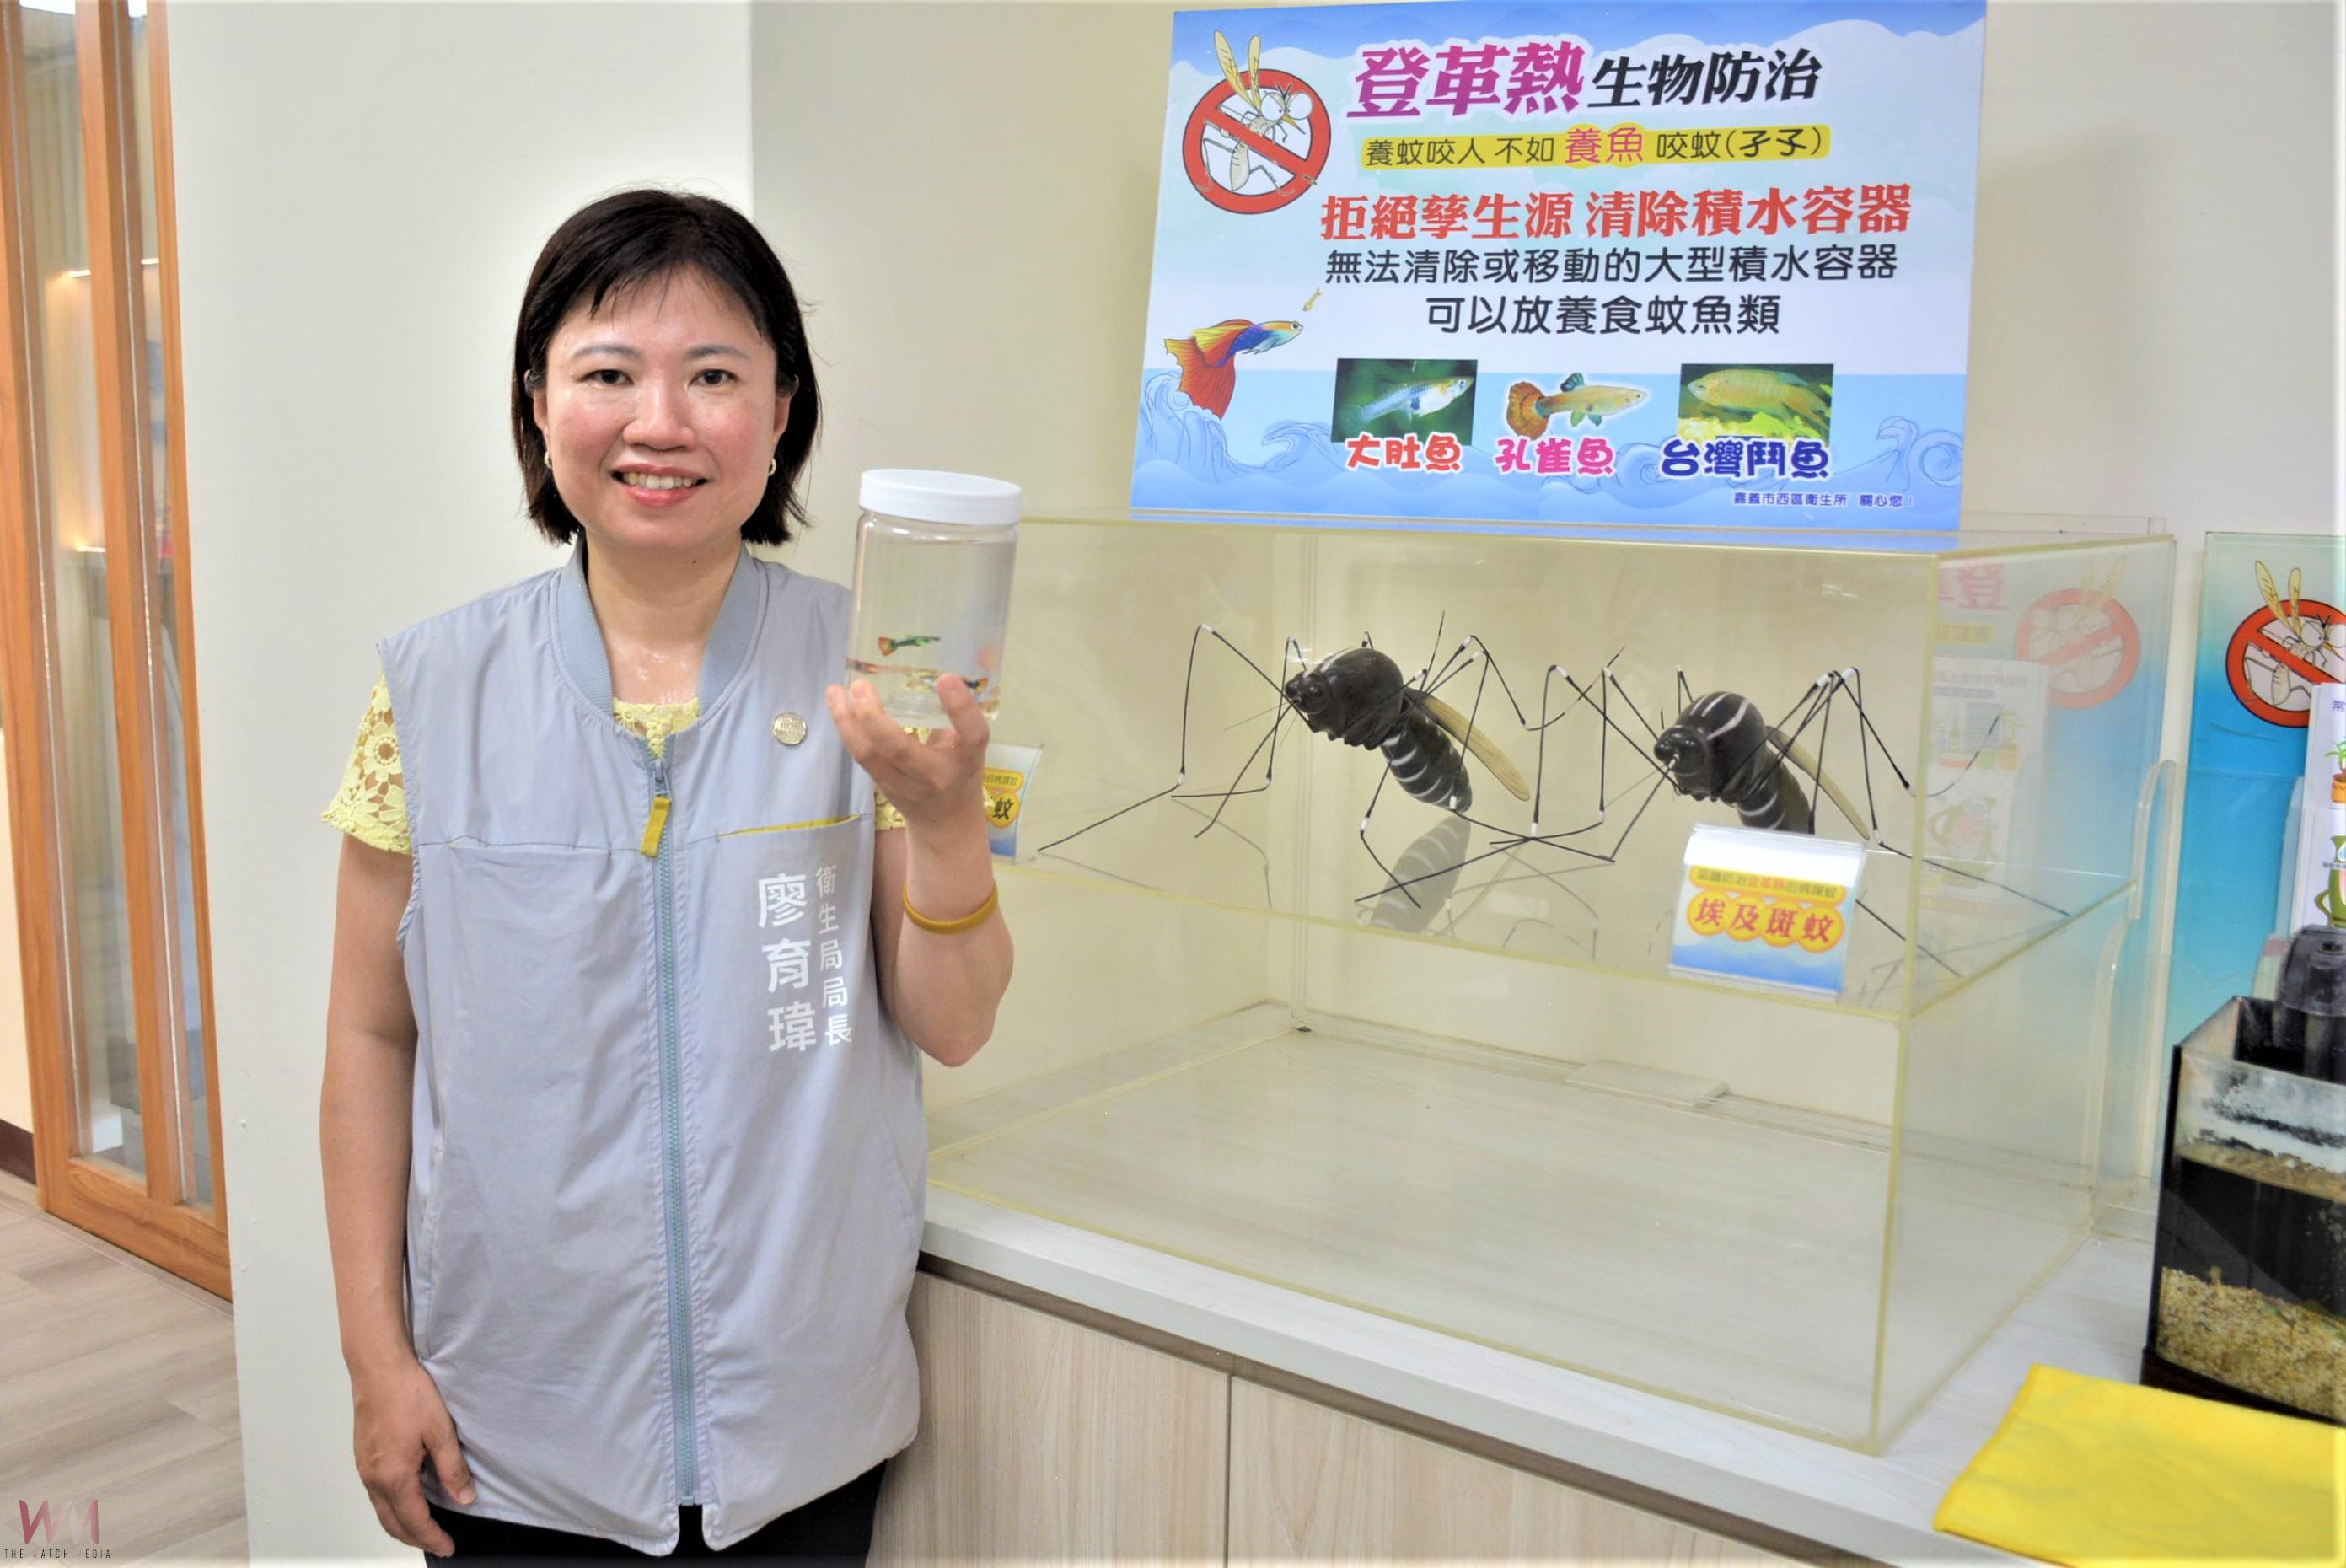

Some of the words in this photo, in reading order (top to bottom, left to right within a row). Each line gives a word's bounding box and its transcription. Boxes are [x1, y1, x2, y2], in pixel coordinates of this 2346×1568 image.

[1366, 137, 1485, 167] 養蚊咬人
[1494, 137, 1554, 164] 不如
[1564, 126, 1645, 165] 養魚
[1320, 191, 1574, 240] 拒絕孽生源
[1586, 183, 1911, 239] 清除積水容器
[1325, 244, 1898, 284] 無法清除或移動的大型積水容器
[1426, 295, 1780, 335] 可以放養食蚊魚類
[1346, 433, 1462, 472] 大肚魚
[1495, 437, 1615, 475] 孔雀魚
[1662, 438, 1829, 478] 台灣鬥魚
[991, 796, 1014, 821] 蚊
[1695, 898, 1835, 943] 埃及斑蚊
[759, 873, 817, 1052] 廖育瑋
[816, 865, 853, 1046] 衛生局局長
